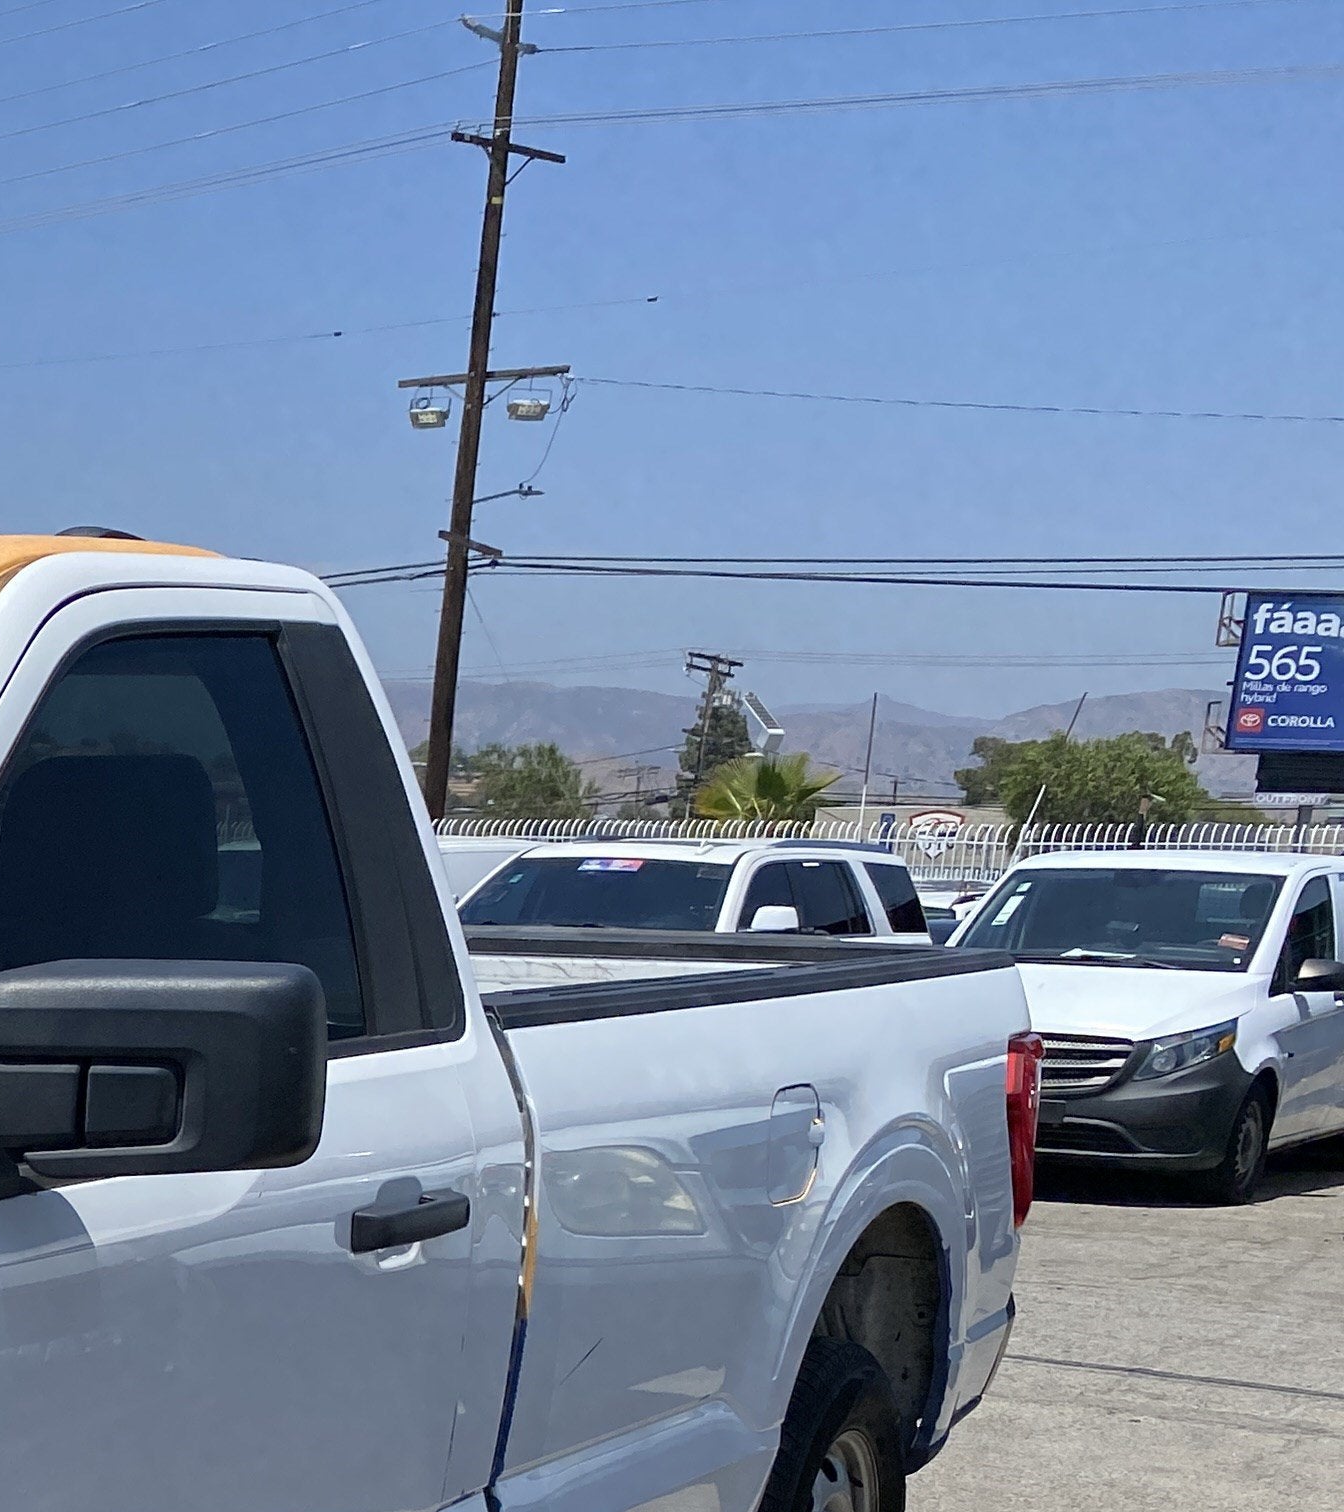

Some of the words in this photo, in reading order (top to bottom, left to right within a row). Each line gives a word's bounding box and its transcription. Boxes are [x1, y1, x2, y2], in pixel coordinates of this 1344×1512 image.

[1253, 602, 1344, 638] fáaa
[1244, 644, 1322, 681] 565
[1242, 681, 1273, 692] Millas
[1276, 682, 1292, 692] de
[1294, 684, 1328, 695] rango
[1240, 692, 1277, 704] hybrid
[1267, 715, 1335, 728] COROLLA
